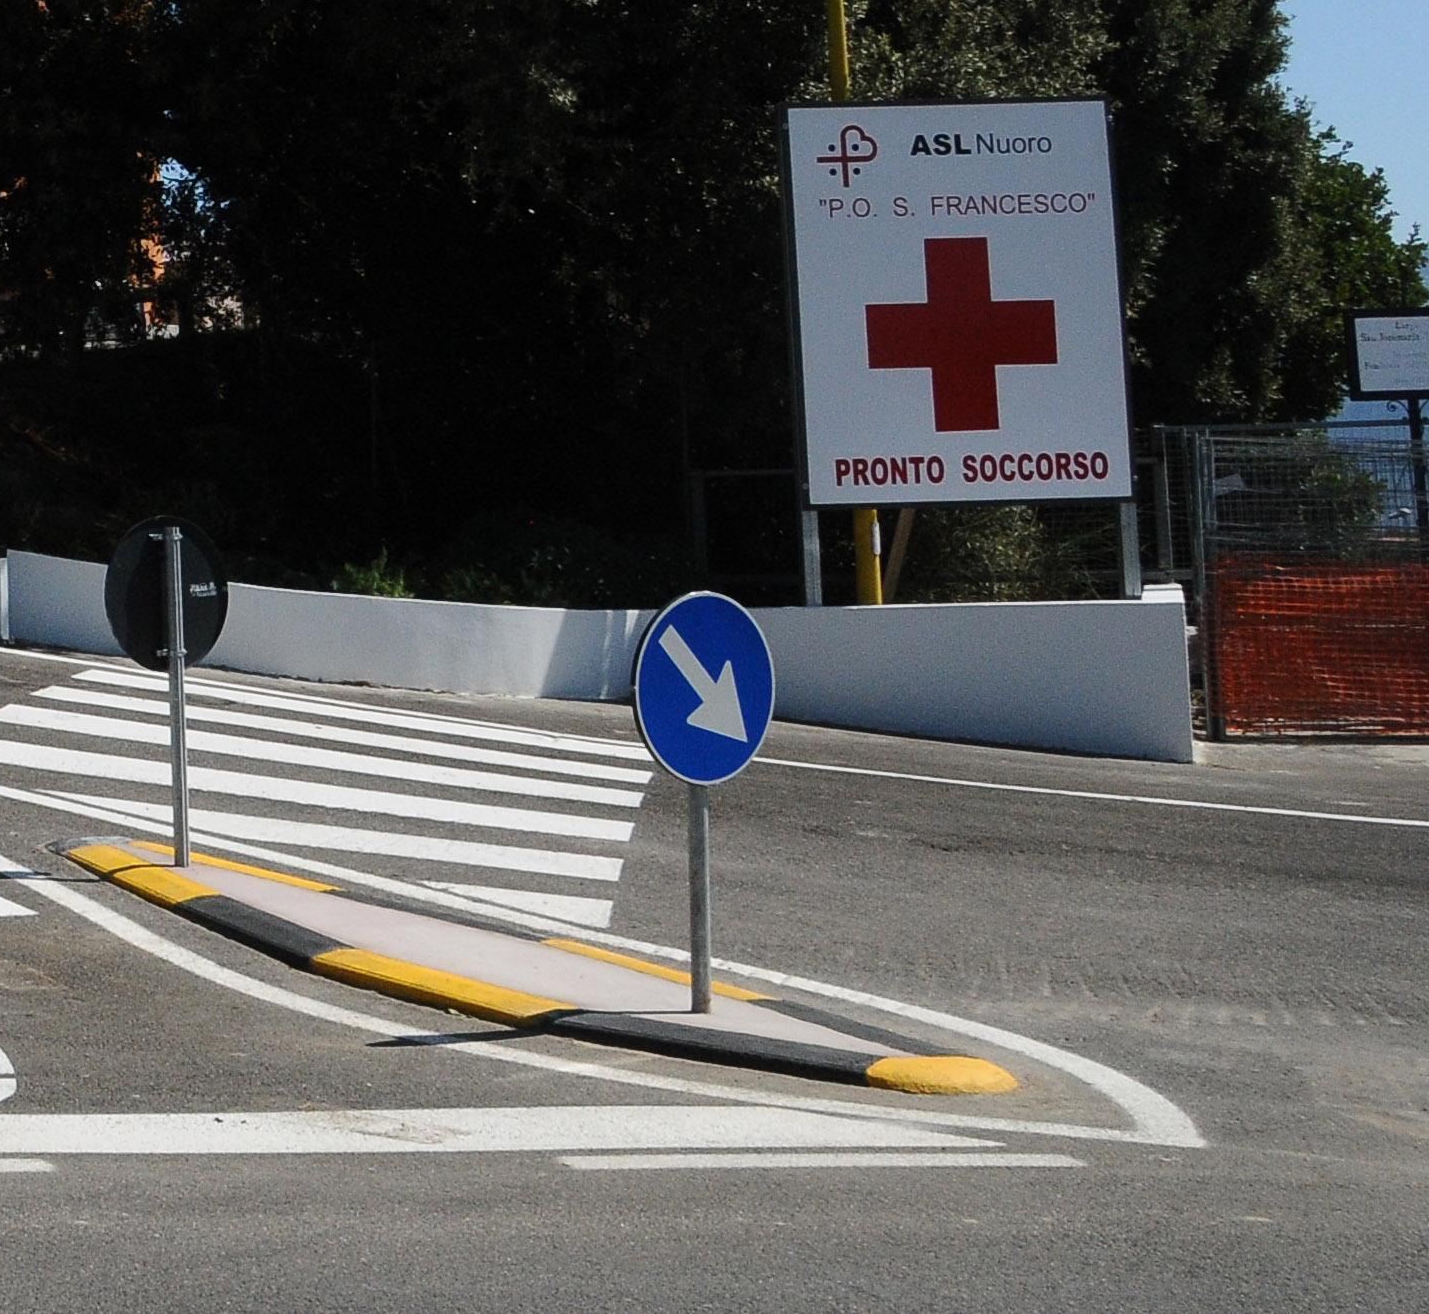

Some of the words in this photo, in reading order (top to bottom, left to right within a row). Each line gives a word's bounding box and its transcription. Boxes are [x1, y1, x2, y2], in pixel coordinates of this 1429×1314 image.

[910, 134, 972, 156] ASL
[976, 133, 1052, 155] Nuoro
[893, 196, 915, 217] S.
[931, 193, 1095, 216] FRANCESCO"
[835, 455, 945, 486] PRONTO
[962, 451, 1109, 483] SOCCORSO
